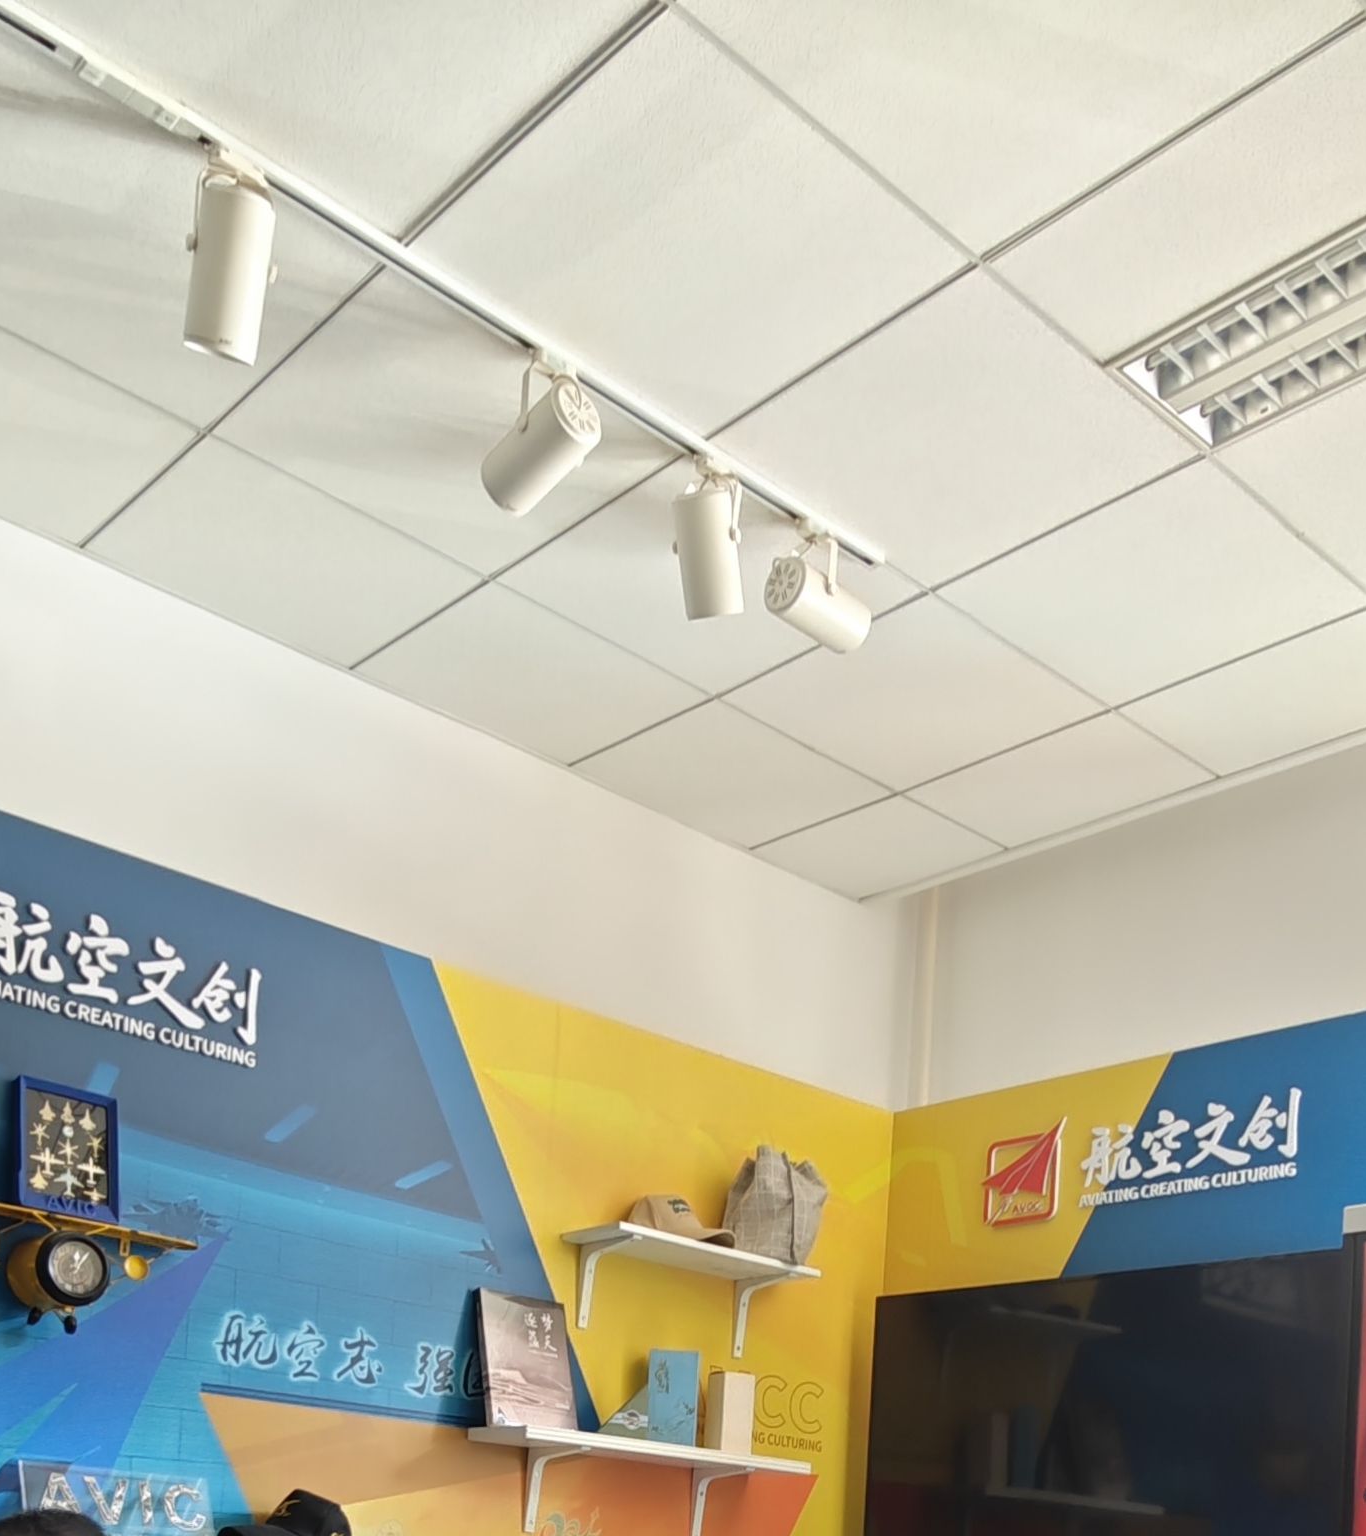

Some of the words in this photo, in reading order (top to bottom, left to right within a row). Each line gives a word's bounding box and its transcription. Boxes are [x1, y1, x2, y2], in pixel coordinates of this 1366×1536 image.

[64, 1000, 156, 1041] CREATING
[158, 1027, 257, 1068] CULTURING
[1081, 1087, 1302, 1188] 航空文创
[1078, 1185, 1139, 1208] AVIATING
[1140, 1175, 1210, 1199] CREATING
[1211, 1162, 1297, 1189] CULTURING
[215, 1314, 382, 1385] 航空志
[767, 1433, 822, 1453] CULTURING
[39, 1472, 206, 1531] AVIC
